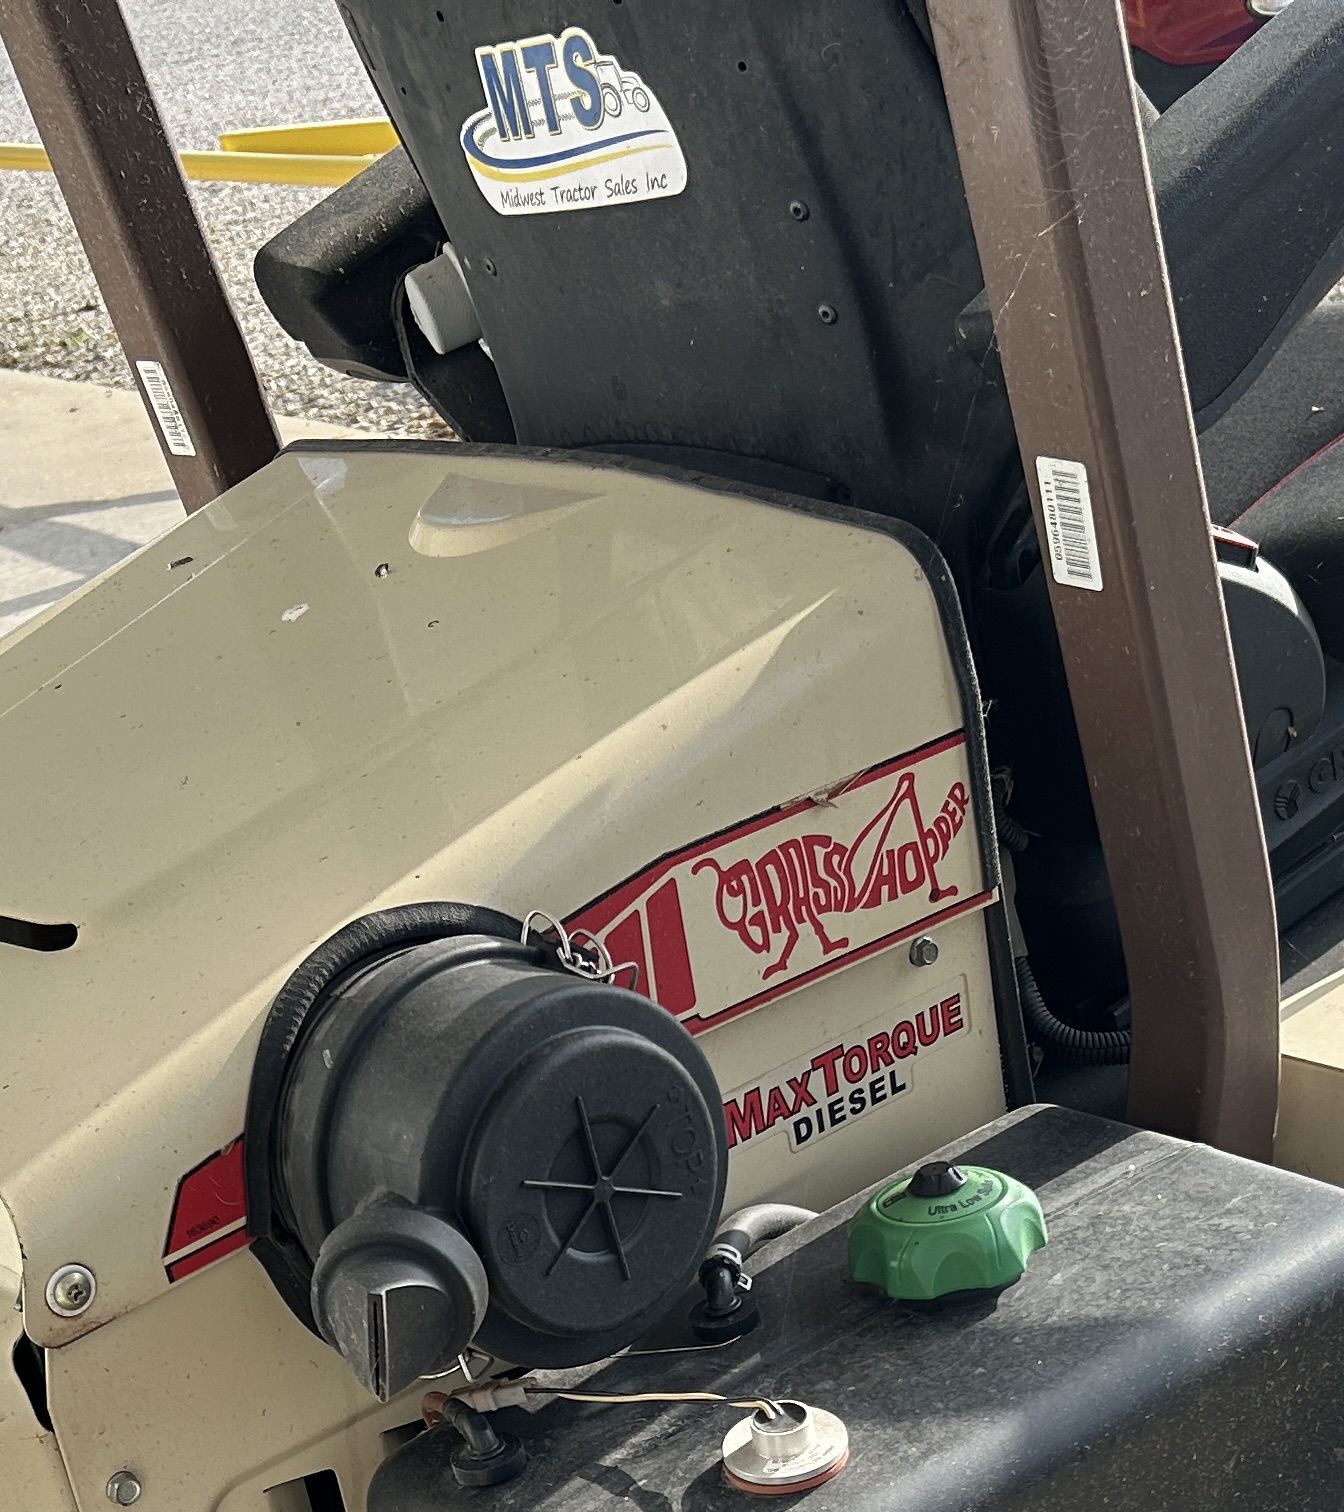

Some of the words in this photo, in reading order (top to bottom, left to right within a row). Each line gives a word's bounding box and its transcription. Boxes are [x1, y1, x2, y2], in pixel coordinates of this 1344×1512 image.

[500, 187, 546, 209] Midwest
[549, 182, 598, 204] Tractor
[604, 173, 638, 198] Sales
[645, 171, 668, 192] Inc
[714, 772, 970, 958] GRASSHOPPER
[793, 1069, 907, 1146] DIESEL
